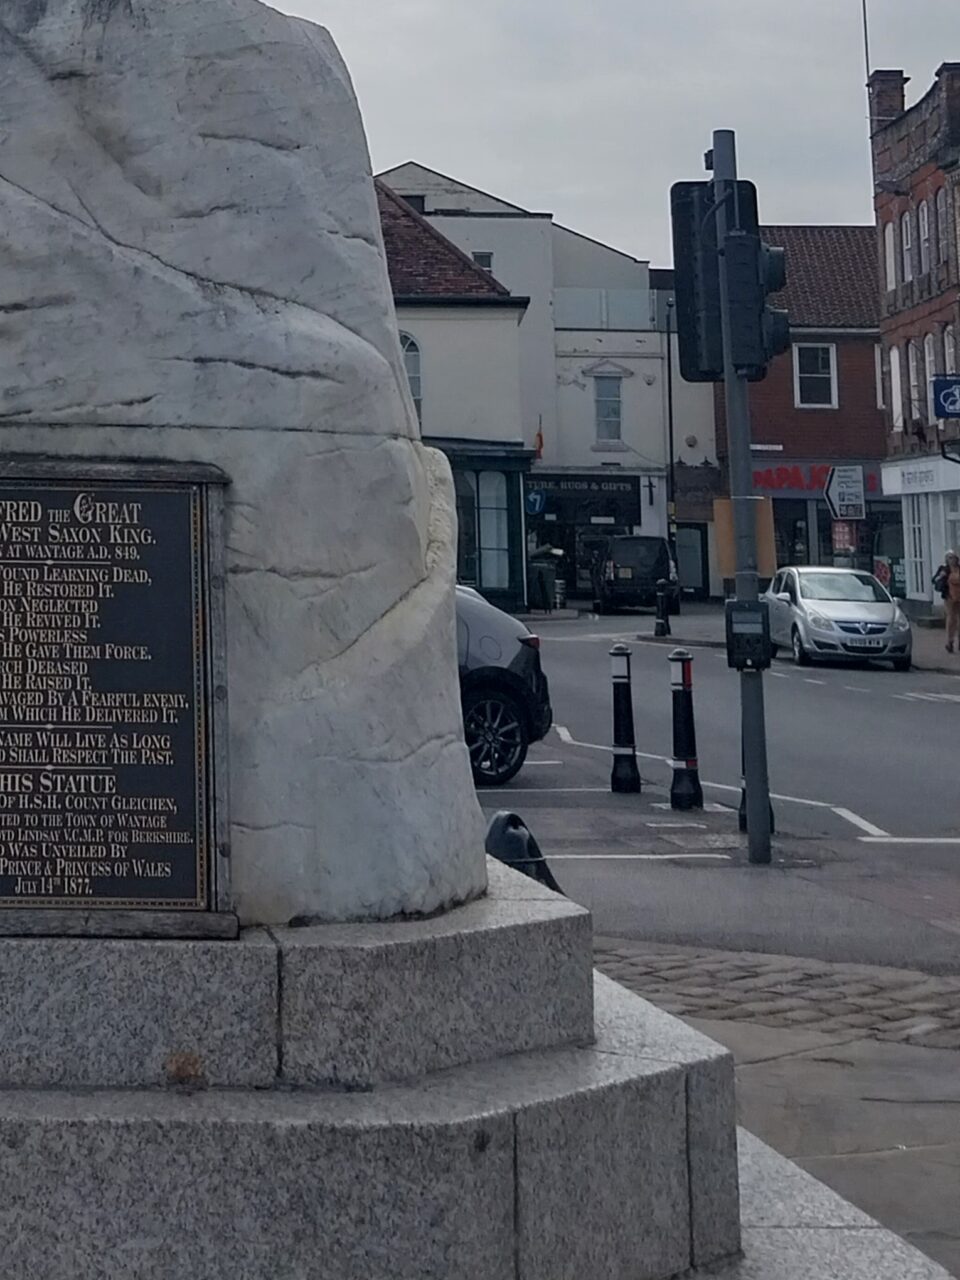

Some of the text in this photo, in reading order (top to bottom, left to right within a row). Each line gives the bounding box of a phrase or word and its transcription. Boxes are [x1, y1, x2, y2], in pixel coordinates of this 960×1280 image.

[589, 482, 598, 491] &
[48, 509, 71, 523] THE
[73, 493, 142, 524] GREAT
[48, 523, 102, 543] SAXON
[6, 545, 22, 558] AT
[25, 545, 84, 559] WANTAGE
[43, 566, 109, 583] LEARNING
[3, 581, 23, 597] HE
[27, 581, 94, 598] RESTORED
[20, 597, 98, 613] NEGLECTED
[3, 612, 22, 627] HE
[26, 612, 81, 628] REVIVED
[9, 627, 88, 644] POWERLESS
[2, 642, 22, 658] HE
[25, 642, 60, 658] GAVE
[63, 643, 100, 659] THEM
[27, 659, 88, 675] DEBASED
[2, 674, 21, 689] HE
[25, 674, 72, 690] RAISED
[47, 690, 65, 706] BY
[68, 690, 78, 706] A
[81, 691, 140, 707] FEARFUL
[12, 705, 57, 722] WHICH
[62, 705, 81, 722] HE
[85, 706, 158, 723] DELIVERED
[36, 732, 72, 748] WILL
[76, 732, 106, 748] LIVE
[109, 733, 128, 749] AS
[132, 733, 171, 749] LONG
[9, 747, 49, 763] SHALL
[52, 748, 108, 764] RESPECT
[111, 748, 138, 765] THE
[40, 772, 117, 794] STATUE
[65, 794, 108, 811] COUNT
[24, 814, 38, 827] TO
[41, 814, 63, 827] THE
[65, 812, 97, 828] TOWN
[100, 814, 115, 828] OF
[117, 813, 168, 829] WANTAGE
[18, 828, 60, 843] LINDSAY
[108, 831, 128, 844] FOR
[8, 842, 38, 858] WAS
[41, 843, 106, 859] UNVEILED
[111, 843, 128, 859] BY
[0, 857, 42, 876] PRINCE
[44, 860, 53, 876] &
[56, 859, 111, 877] PRINCESS
[114, 861, 130, 877] OF
[132, 860, 171, 877] WALES
[15, 877, 38, 894] JULY
